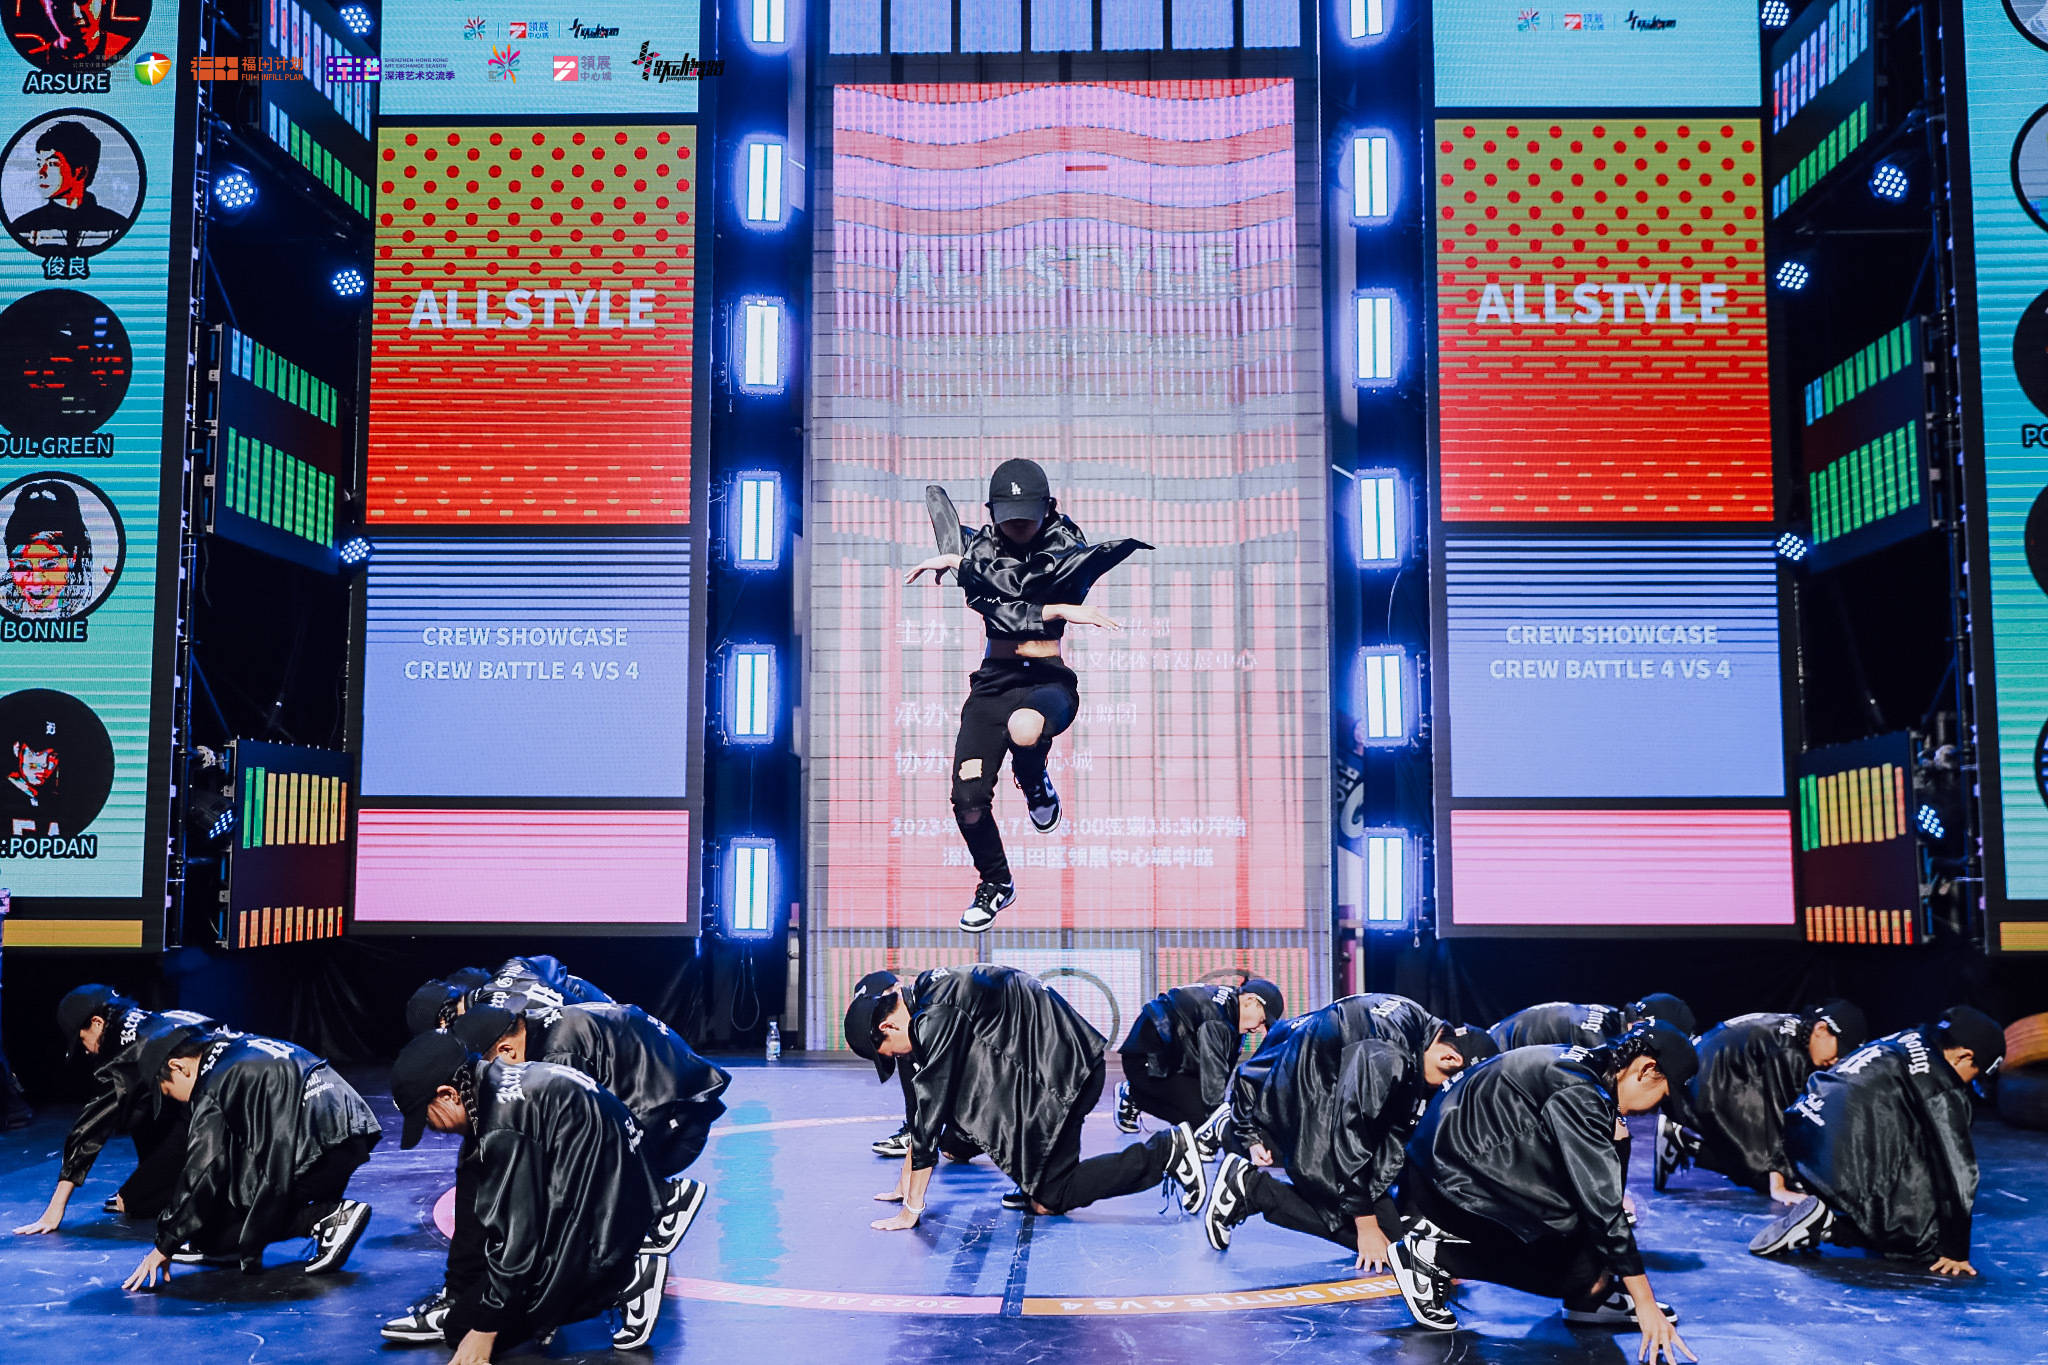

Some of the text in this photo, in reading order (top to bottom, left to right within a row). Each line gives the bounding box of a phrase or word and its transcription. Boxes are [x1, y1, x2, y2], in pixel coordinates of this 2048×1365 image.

[26, 73, 108, 91] ARSURE
[45, 256, 87, 276] 俊良
[408, 288, 656, 329] ALLSTYLE
[1475, 283, 1729, 323] ALLSTYLE
[4, 621, 86, 639] BONNIE
[422, 627, 628, 646] CREW SHOWCASE
[1505, 625, 1718, 645] CREW SHOWCASE
[404, 661, 639, 680] CREW BATTLE 4 VS 4
[1490, 659, 1731, 680] CREW BATTLE 4 VS 4
[868, 1299, 963, 1309] 2023
[1060, 1279, 1398, 1310] REW BATTLE 4 VS 4
